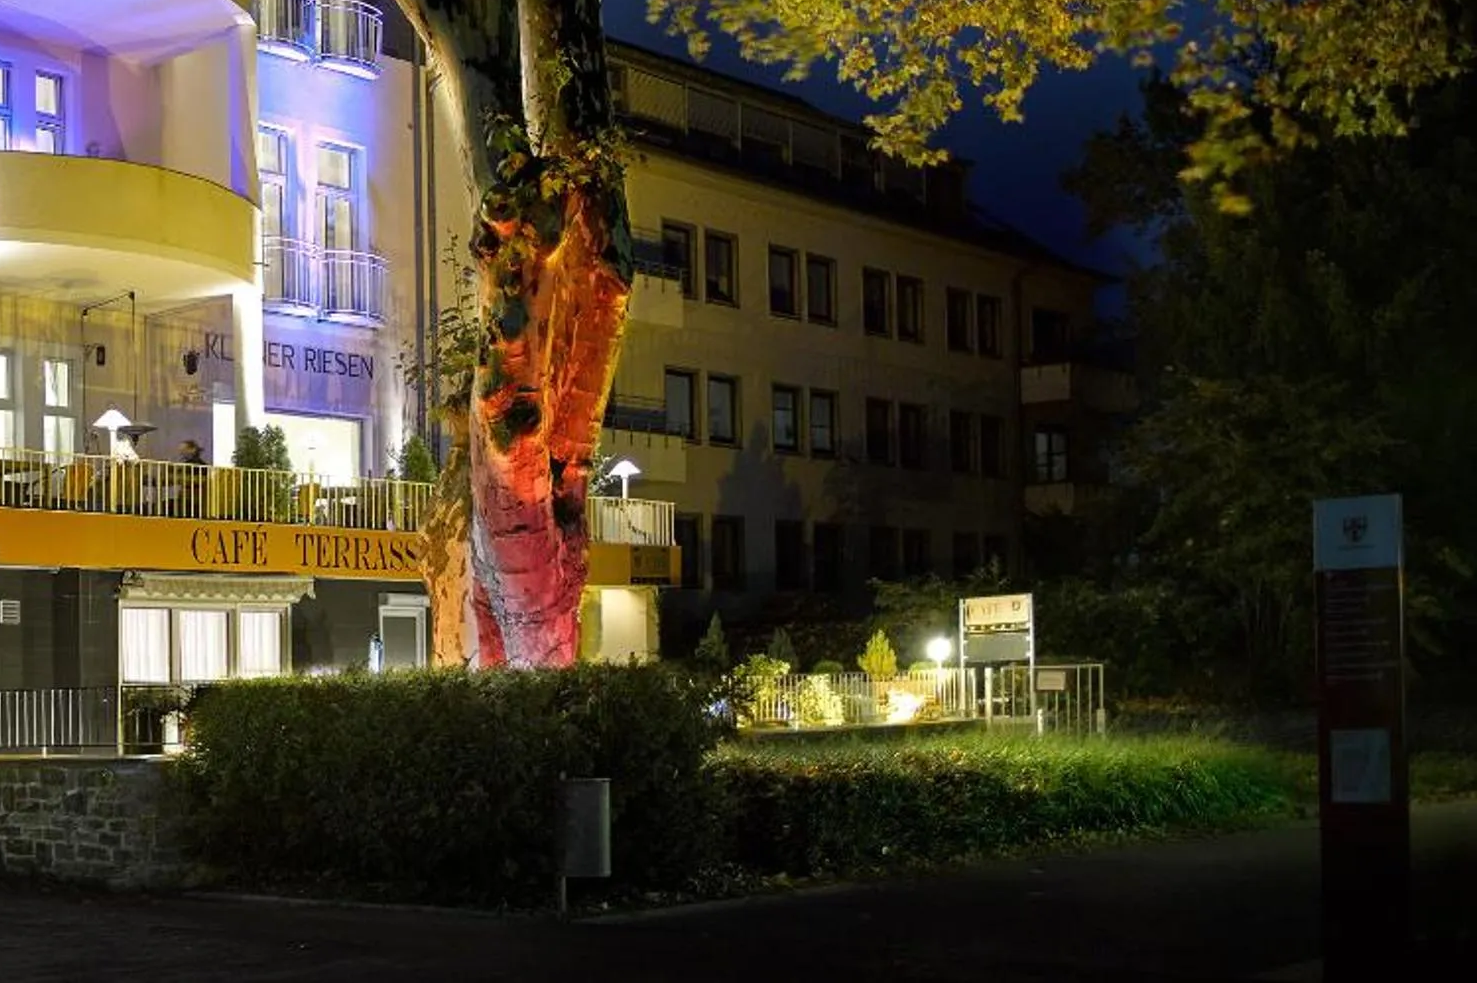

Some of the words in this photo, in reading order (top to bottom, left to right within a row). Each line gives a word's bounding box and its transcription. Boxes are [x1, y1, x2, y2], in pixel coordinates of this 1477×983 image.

[205, 332, 294, 370] KLER
[304, 346, 374, 380] RIESEN
[191, 524, 268, 566] CAFÉ
[294, 533, 418, 572] TERRASS
